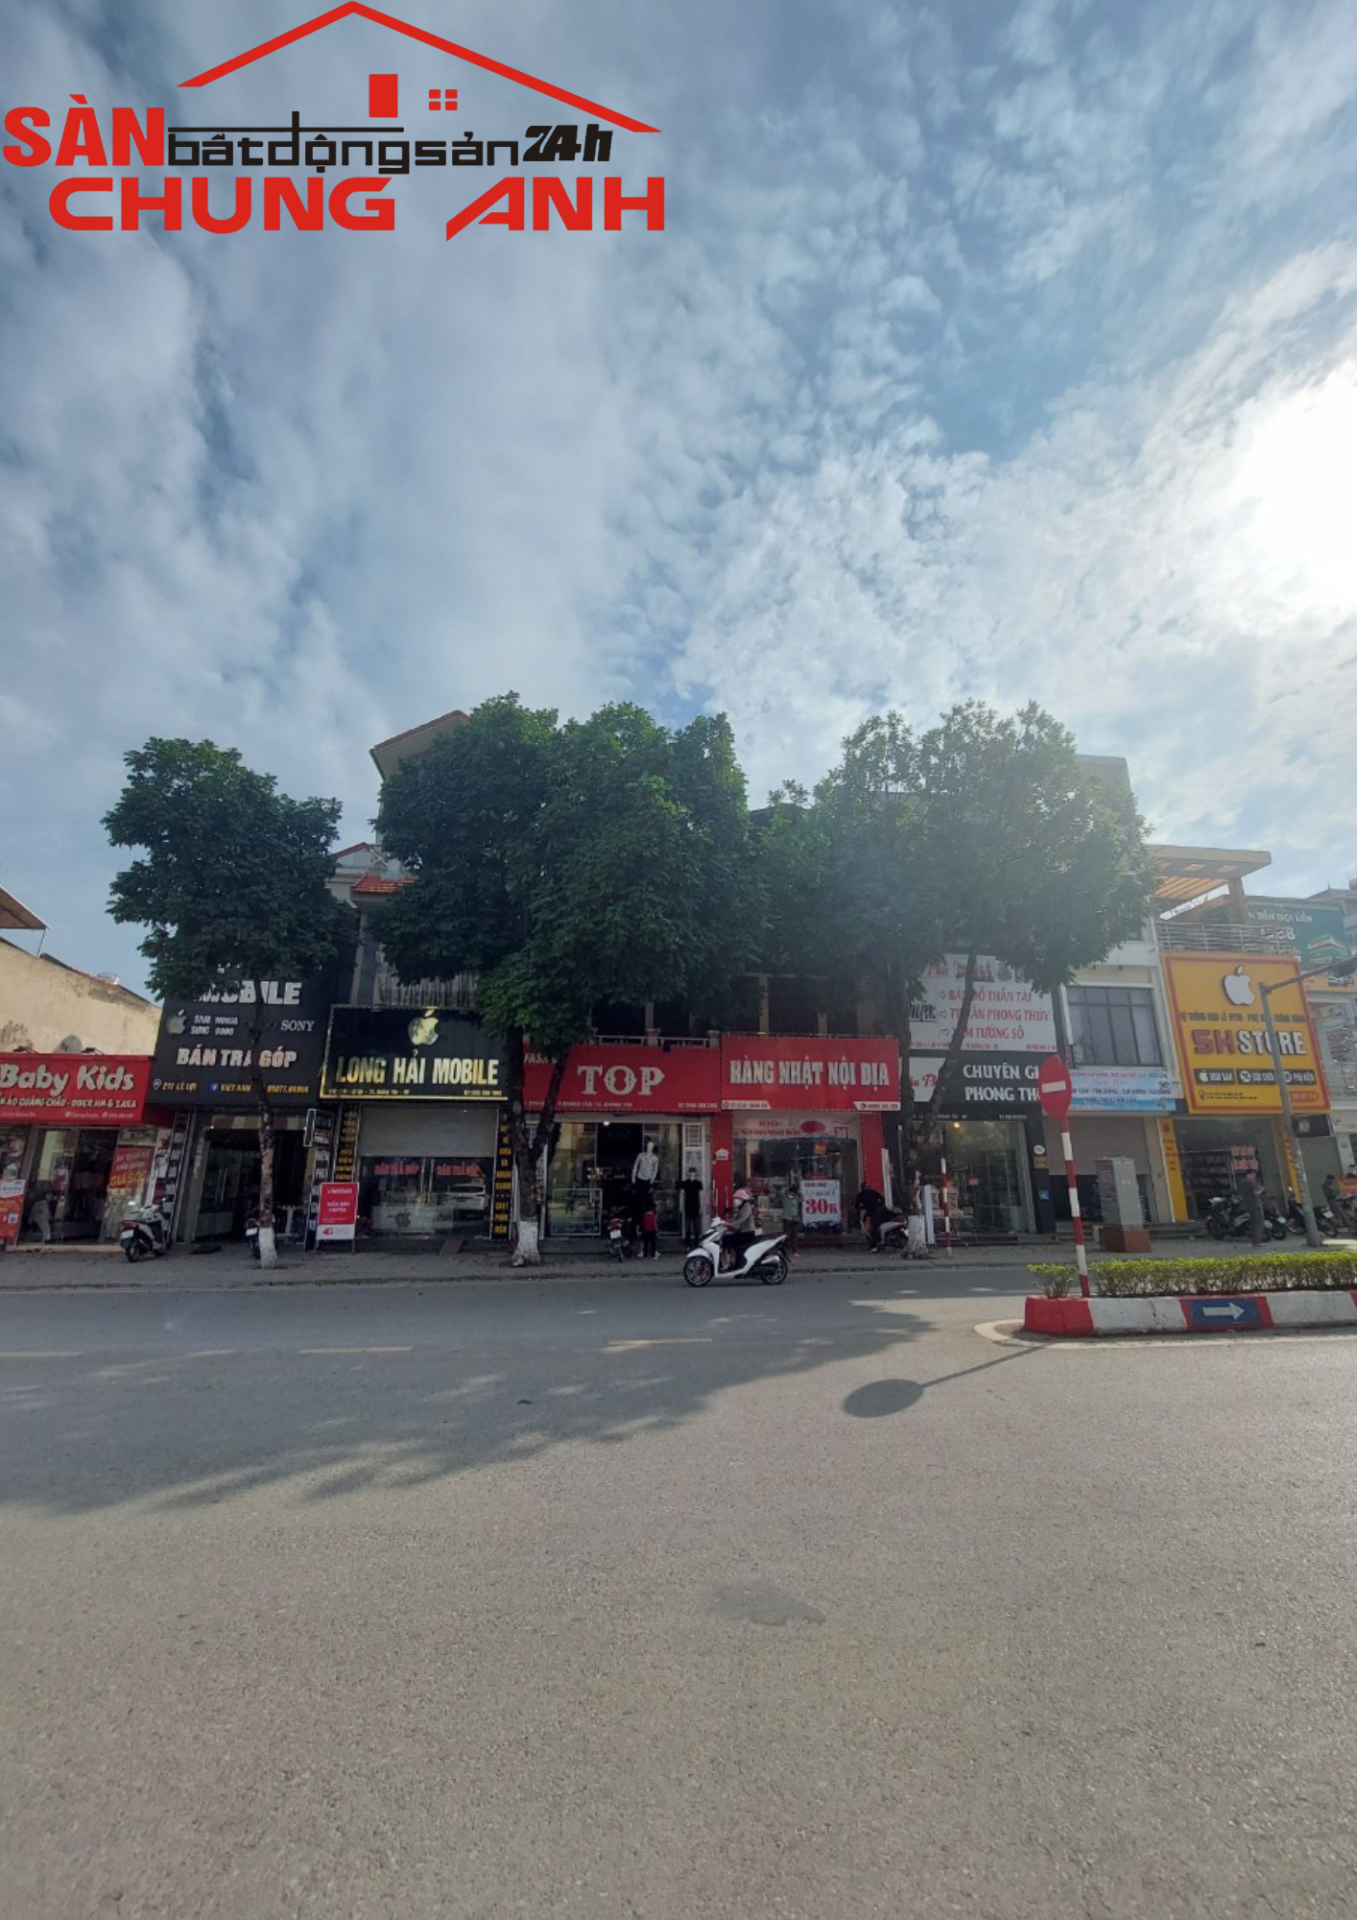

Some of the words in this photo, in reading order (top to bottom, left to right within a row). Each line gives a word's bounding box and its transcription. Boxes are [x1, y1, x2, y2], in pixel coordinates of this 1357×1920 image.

[281, 1020, 314, 1032] SONY
[987, 1009, 1021, 1021] PHONG
[1192, 1029, 1235, 1055] SH
[176, 1044, 217, 1066] BÁN
[258, 1046, 297, 1068] GÓP
[336, 1056, 386, 1083] LONG
[393, 1048, 426, 1084] HẢI
[432, 1057, 499, 1085] MOBILE
[0, 1064, 69, 1097] Baby
[77, 1065, 135, 1091] Kids
[577, 1065, 666, 1096] TOP
[730, 1055, 775, 1084] HÀNG
[778, 1056, 823, 1090] NHẬT
[828, 1056, 856, 1090] NỘI
[963, 1062, 1020, 1080] CHUYÊN
[965, 1087, 1014, 1101] PHONG
